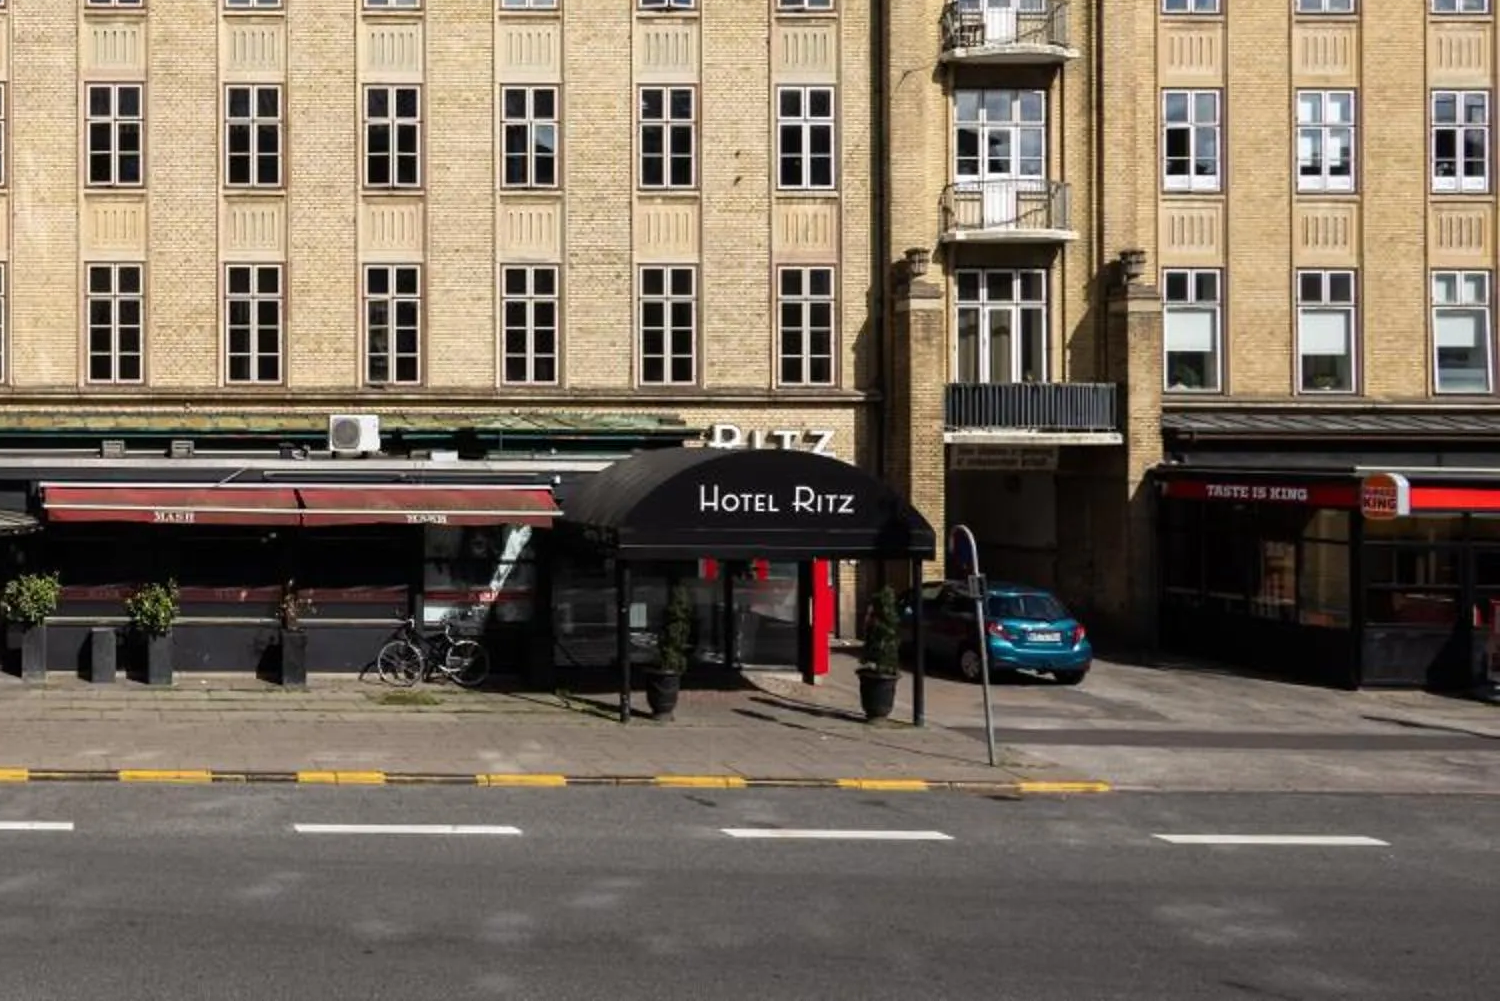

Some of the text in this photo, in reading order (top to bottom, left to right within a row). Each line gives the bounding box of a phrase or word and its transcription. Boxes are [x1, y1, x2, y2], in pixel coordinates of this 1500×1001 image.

[709, 424, 836, 457] RITZ
[1206, 484, 1308, 501] TASTE IS KING
[1363, 496, 1396, 510] KING
